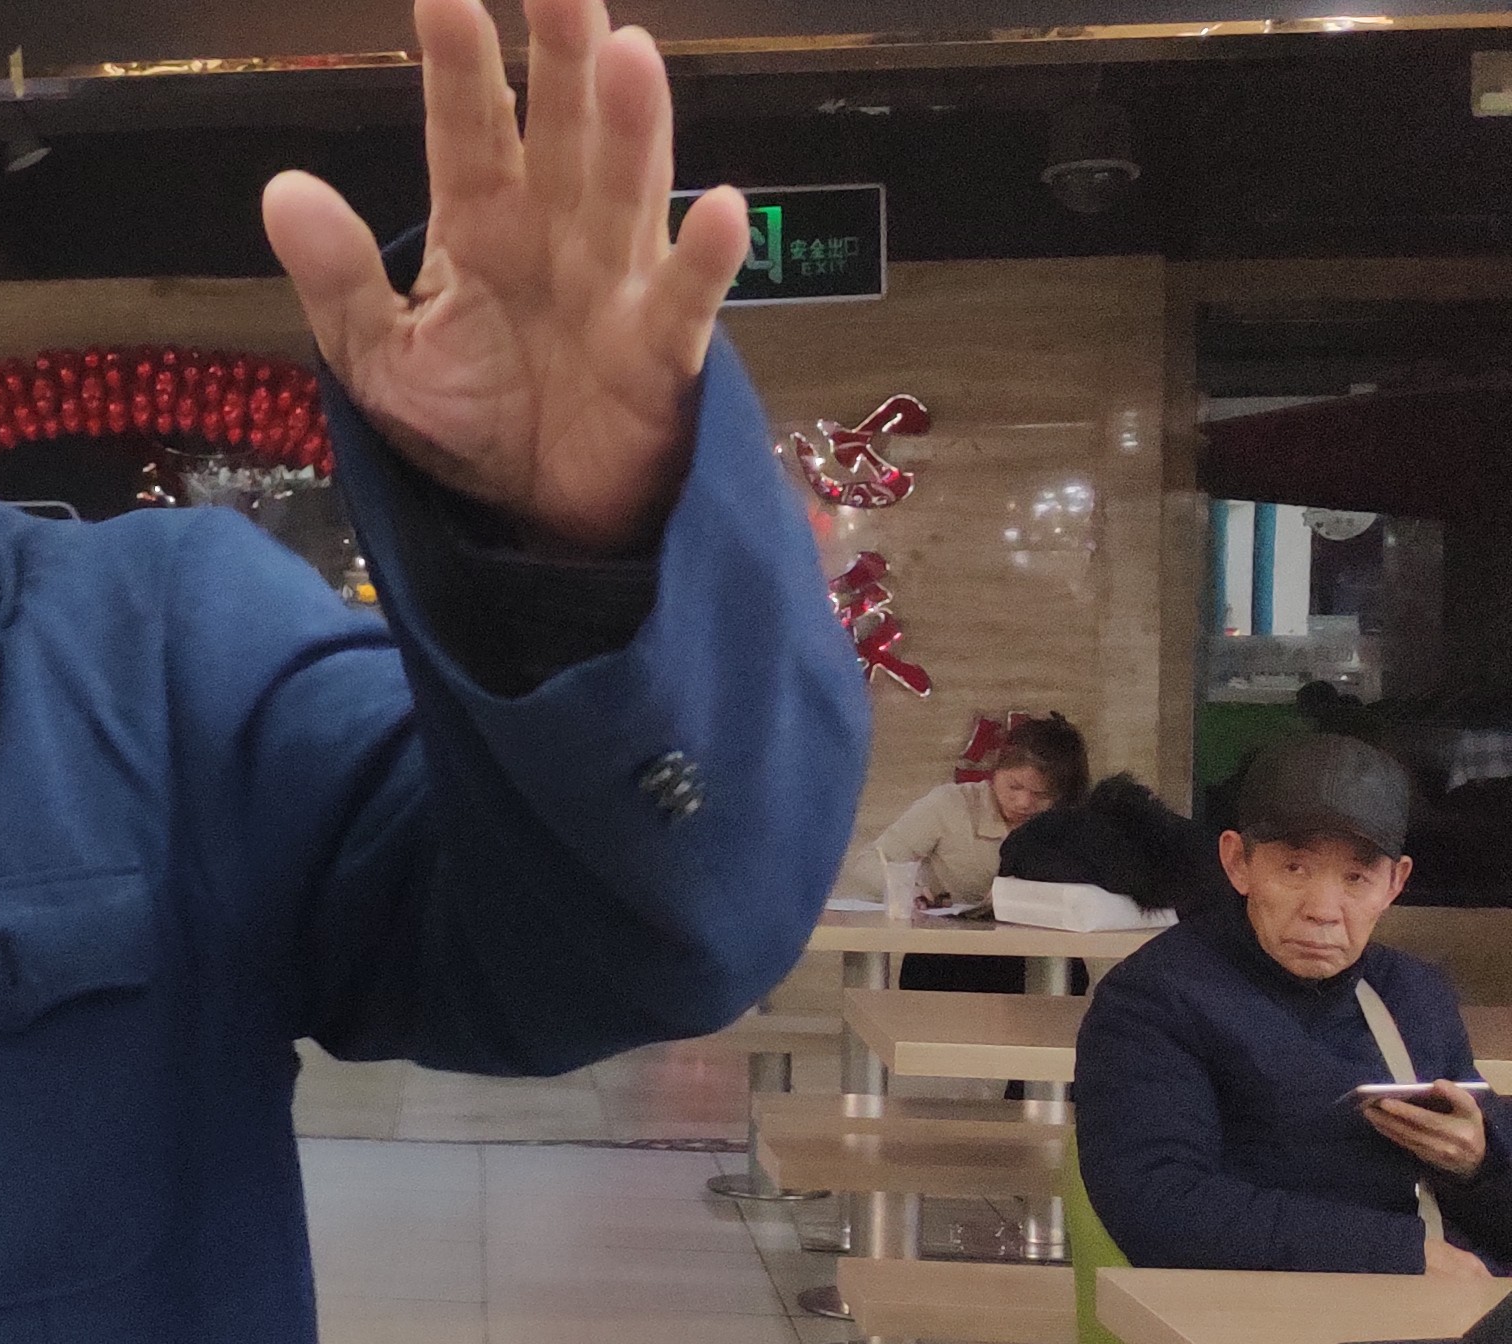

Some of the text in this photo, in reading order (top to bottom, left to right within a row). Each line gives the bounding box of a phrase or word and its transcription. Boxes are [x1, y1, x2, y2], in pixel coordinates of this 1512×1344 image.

[790, 237, 859, 260] 安全出口
[800, 259, 847, 276] EXIT
